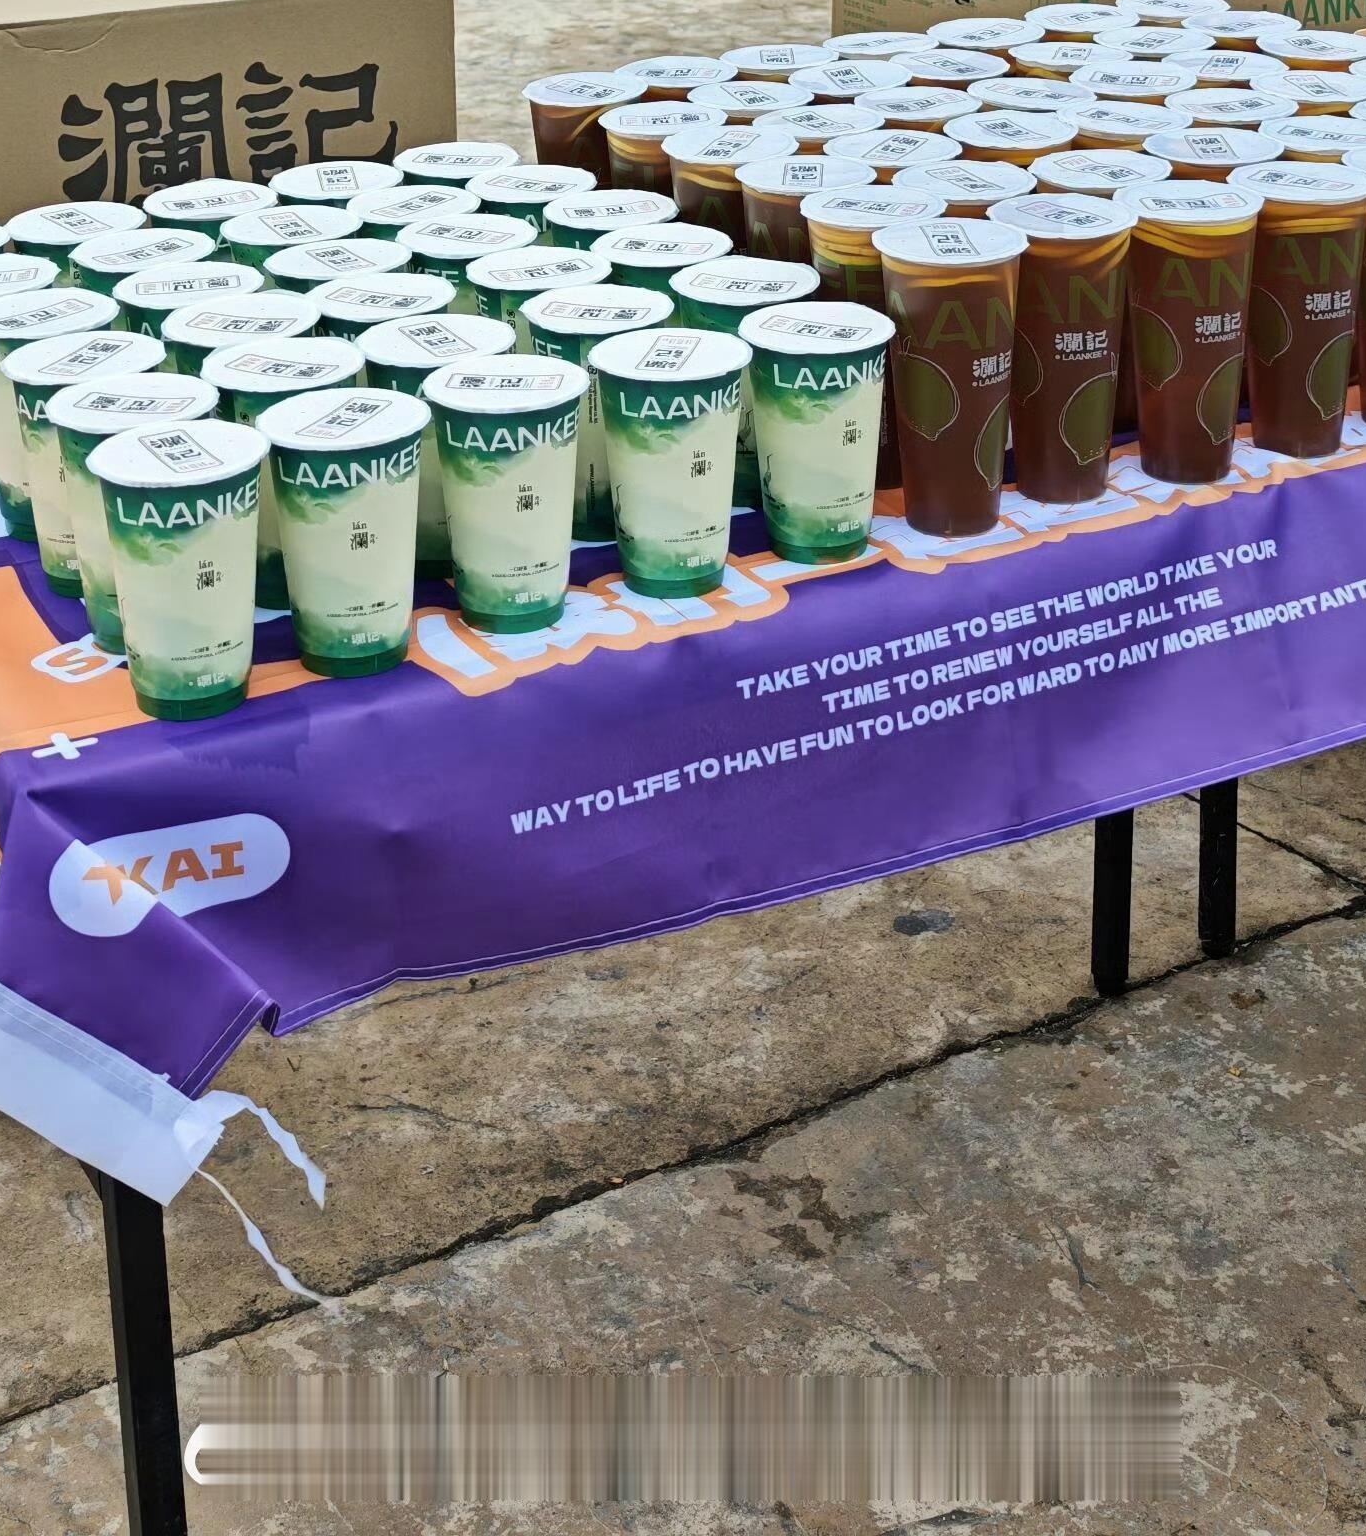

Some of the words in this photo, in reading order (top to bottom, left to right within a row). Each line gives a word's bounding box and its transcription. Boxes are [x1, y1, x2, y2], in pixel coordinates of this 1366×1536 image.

[58, 61, 399, 207] 瀾記
[1062, 349, 1103, 361] LAANKEE
[736, 663, 811, 700] TAKE
[810, 645, 883, 681] YOUR
[884, 625, 952, 662] TIME
[952, 616, 988, 644] TO
[989, 602, 1038, 635] SEE
[1037, 589, 1085, 621] THE
[1085, 571, 1161, 607] WORLD
[1160, 554, 1218, 587] TAKE
[1217, 538, 1278, 570] YOUR
[821, 678, 891, 714] TIME
[892, 669, 930, 696] TO
[931, 645, 1015, 686] RENEW
[1015, 617, 1134, 664] YOURSELF
[1135, 601, 1175, 632] ALL
[1175, 586, 1223, 618] THE
[509, 800, 576, 836] WAY
[575, 789, 615, 818] TO
[616, 768, 682, 806] LIFE
[683, 757, 722, 785] TO
[722, 738, 799, 775] HAVE
[799, 723, 855, 757] FUN
[856, 713, 896, 742] TO
[896, 694, 966, 732] LOOK
[967, 679, 1016, 712] FOR
[1017, 660, 1083, 697] WARD
[1083, 650, 1117, 677] TO
[1116, 635, 1162, 669] ANY
[1162, 617, 1233, 655] MORE
